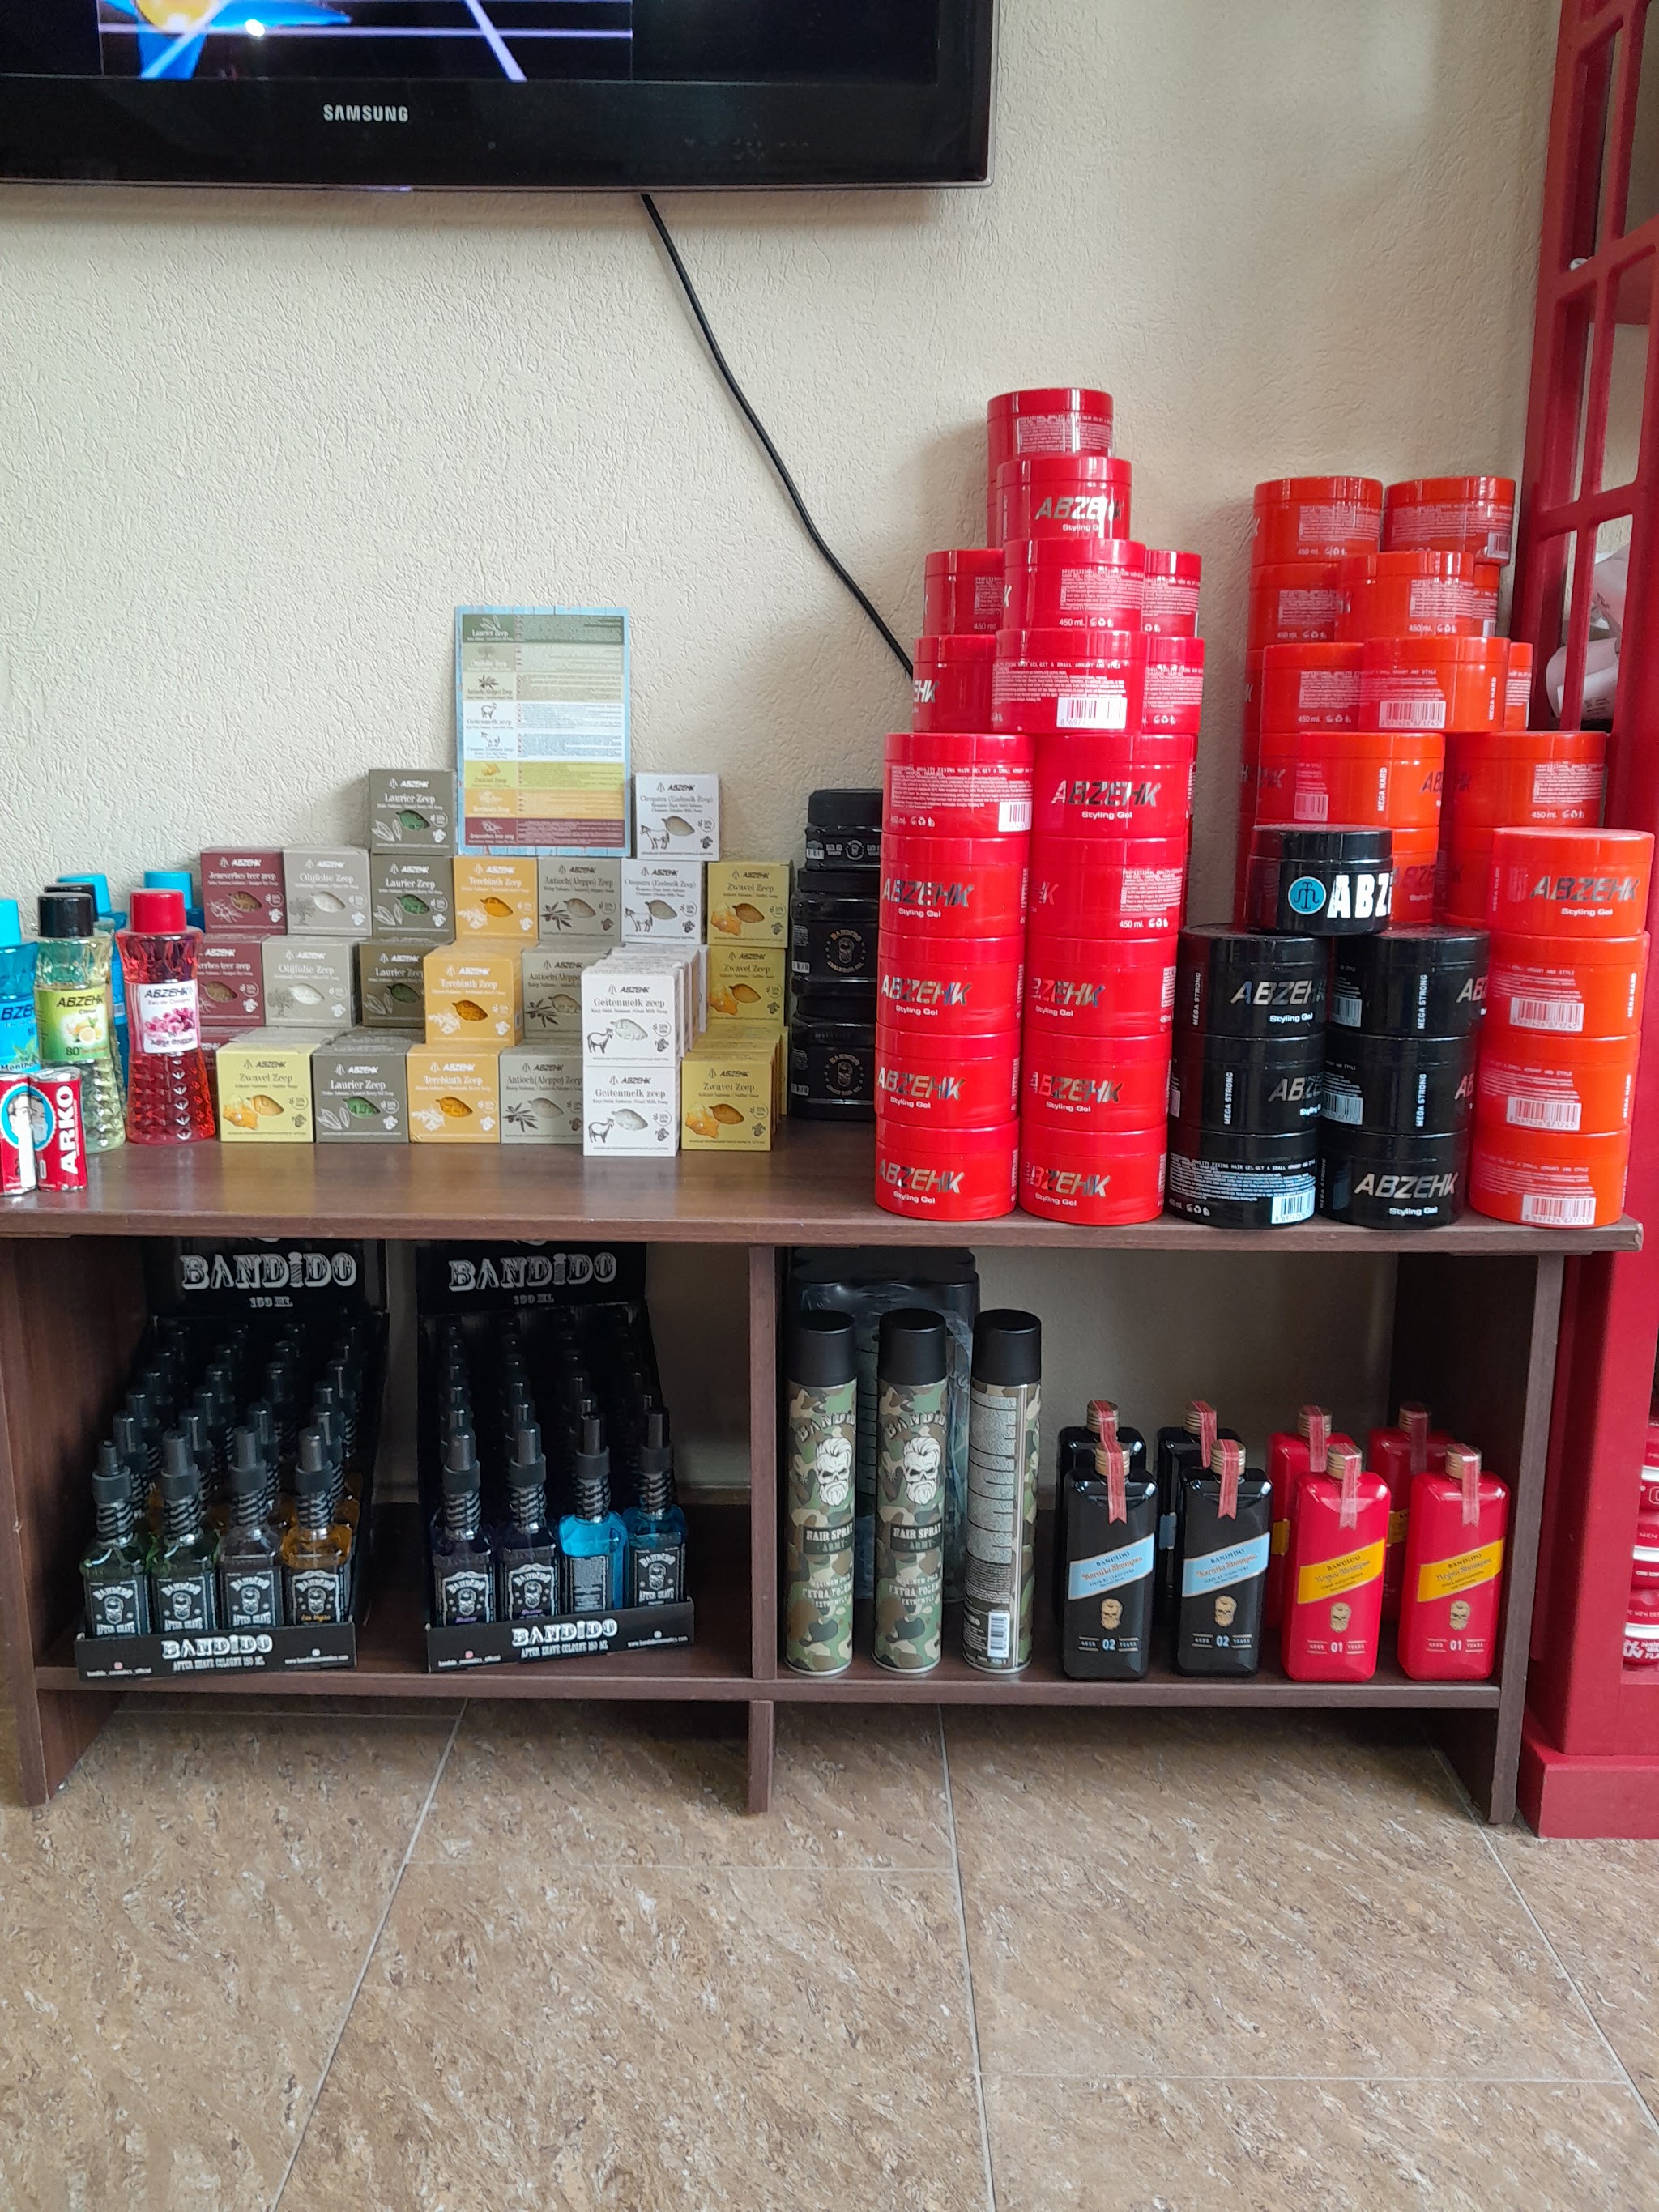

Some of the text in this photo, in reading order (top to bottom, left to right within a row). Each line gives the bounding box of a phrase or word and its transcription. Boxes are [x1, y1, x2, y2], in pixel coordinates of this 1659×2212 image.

[323, 104, 409, 122] SAMSUNG
[1059, 618, 1074, 627] 450
[1298, 715, 1311, 723] 450
[385, 793, 436, 805] Laurier Zeep
[1051, 779, 1162, 807] ABZEHK
[1377, 788, 1385, 812] MEGA
[1081, 811, 1132, 820] Styling Gel
[386, 878, 436, 889] Laurier Zeep
[1529, 876, 1640, 902] ABZEHK
[882, 877, 974, 907] ABZEHK
[898, 907, 941, 918] Styling Gel
[1561, 908, 1596, 917] Styling
[1119, 919, 1132, 928] 450
[478, 980, 498, 991] Zeep
[881, 974, 972, 1006] ABZEHK
[1418, 974, 1427, 1005] STRONG
[594, 998, 666, 1009] Geitenmelk zeep
[895, 1004, 938, 1016] Styling Gel
[1035, 1005, 1074, 1017] Styling Gel
[1269, 1015, 1299, 1024] Styling
[240, 1073, 293, 1085] Zwavel Zeep
[463, 1076, 483, 1086] Zeep
[877, 1066, 966, 1101] ABZEHK
[331, 1080, 386, 1091] Laurier Zeep
[703, 1082, 755, 1093] Zwavel Zeep
[1225, 1072, 1234, 1102] STRONG
[595, 1088, 666, 1099] Geitenmelk zeep
[890, 1096, 931, 1109] Styling Gel
[1416, 1073, 1427, 1127] MEGA STRONG
[1046, 1101, 1091, 1113] Styling Gel
[56, 1085, 79, 1174] ARKO
[880, 1159, 965, 1194] ABZEHK
[1354, 1172, 1458, 1199] ABZEHK
[893, 1191, 936, 1204] Styling Gel
[1034, 1192, 1077, 1206] Styling Gel
[1389, 1207, 1421, 1217] Styling
[179, 1252, 357, 1291] BANDIDO
[448, 1252, 616, 1292] BANDIDO
[806, 1530, 830, 1541] HAIR
[893, 1522, 942, 1539] HAIR SPRAY
[1096, 1550, 1131, 1567] BANDIDO
[1210, 1548, 1245, 1564] BANDIDO
[1448, 1553, 1482, 1569] BANDIDO
[1327, 1555, 1361, 1571] BANDIDO
[802, 1588, 830, 1599] EXTRA
[889, 1586, 916, 1597] EXTRA
[511, 1618, 618, 1647] BANDIDO
[161, 1634, 274, 1660] BANDIDO
[1102, 1638, 1116, 1651] 02
[1216, 1635, 1230, 1647] 02
[1330, 1641, 1344, 1653] 01
[1448, 1639, 1462, 1651] 01
[521, 1647, 540, 1659] AFTER
[173, 1660, 194, 1672] AFTER
